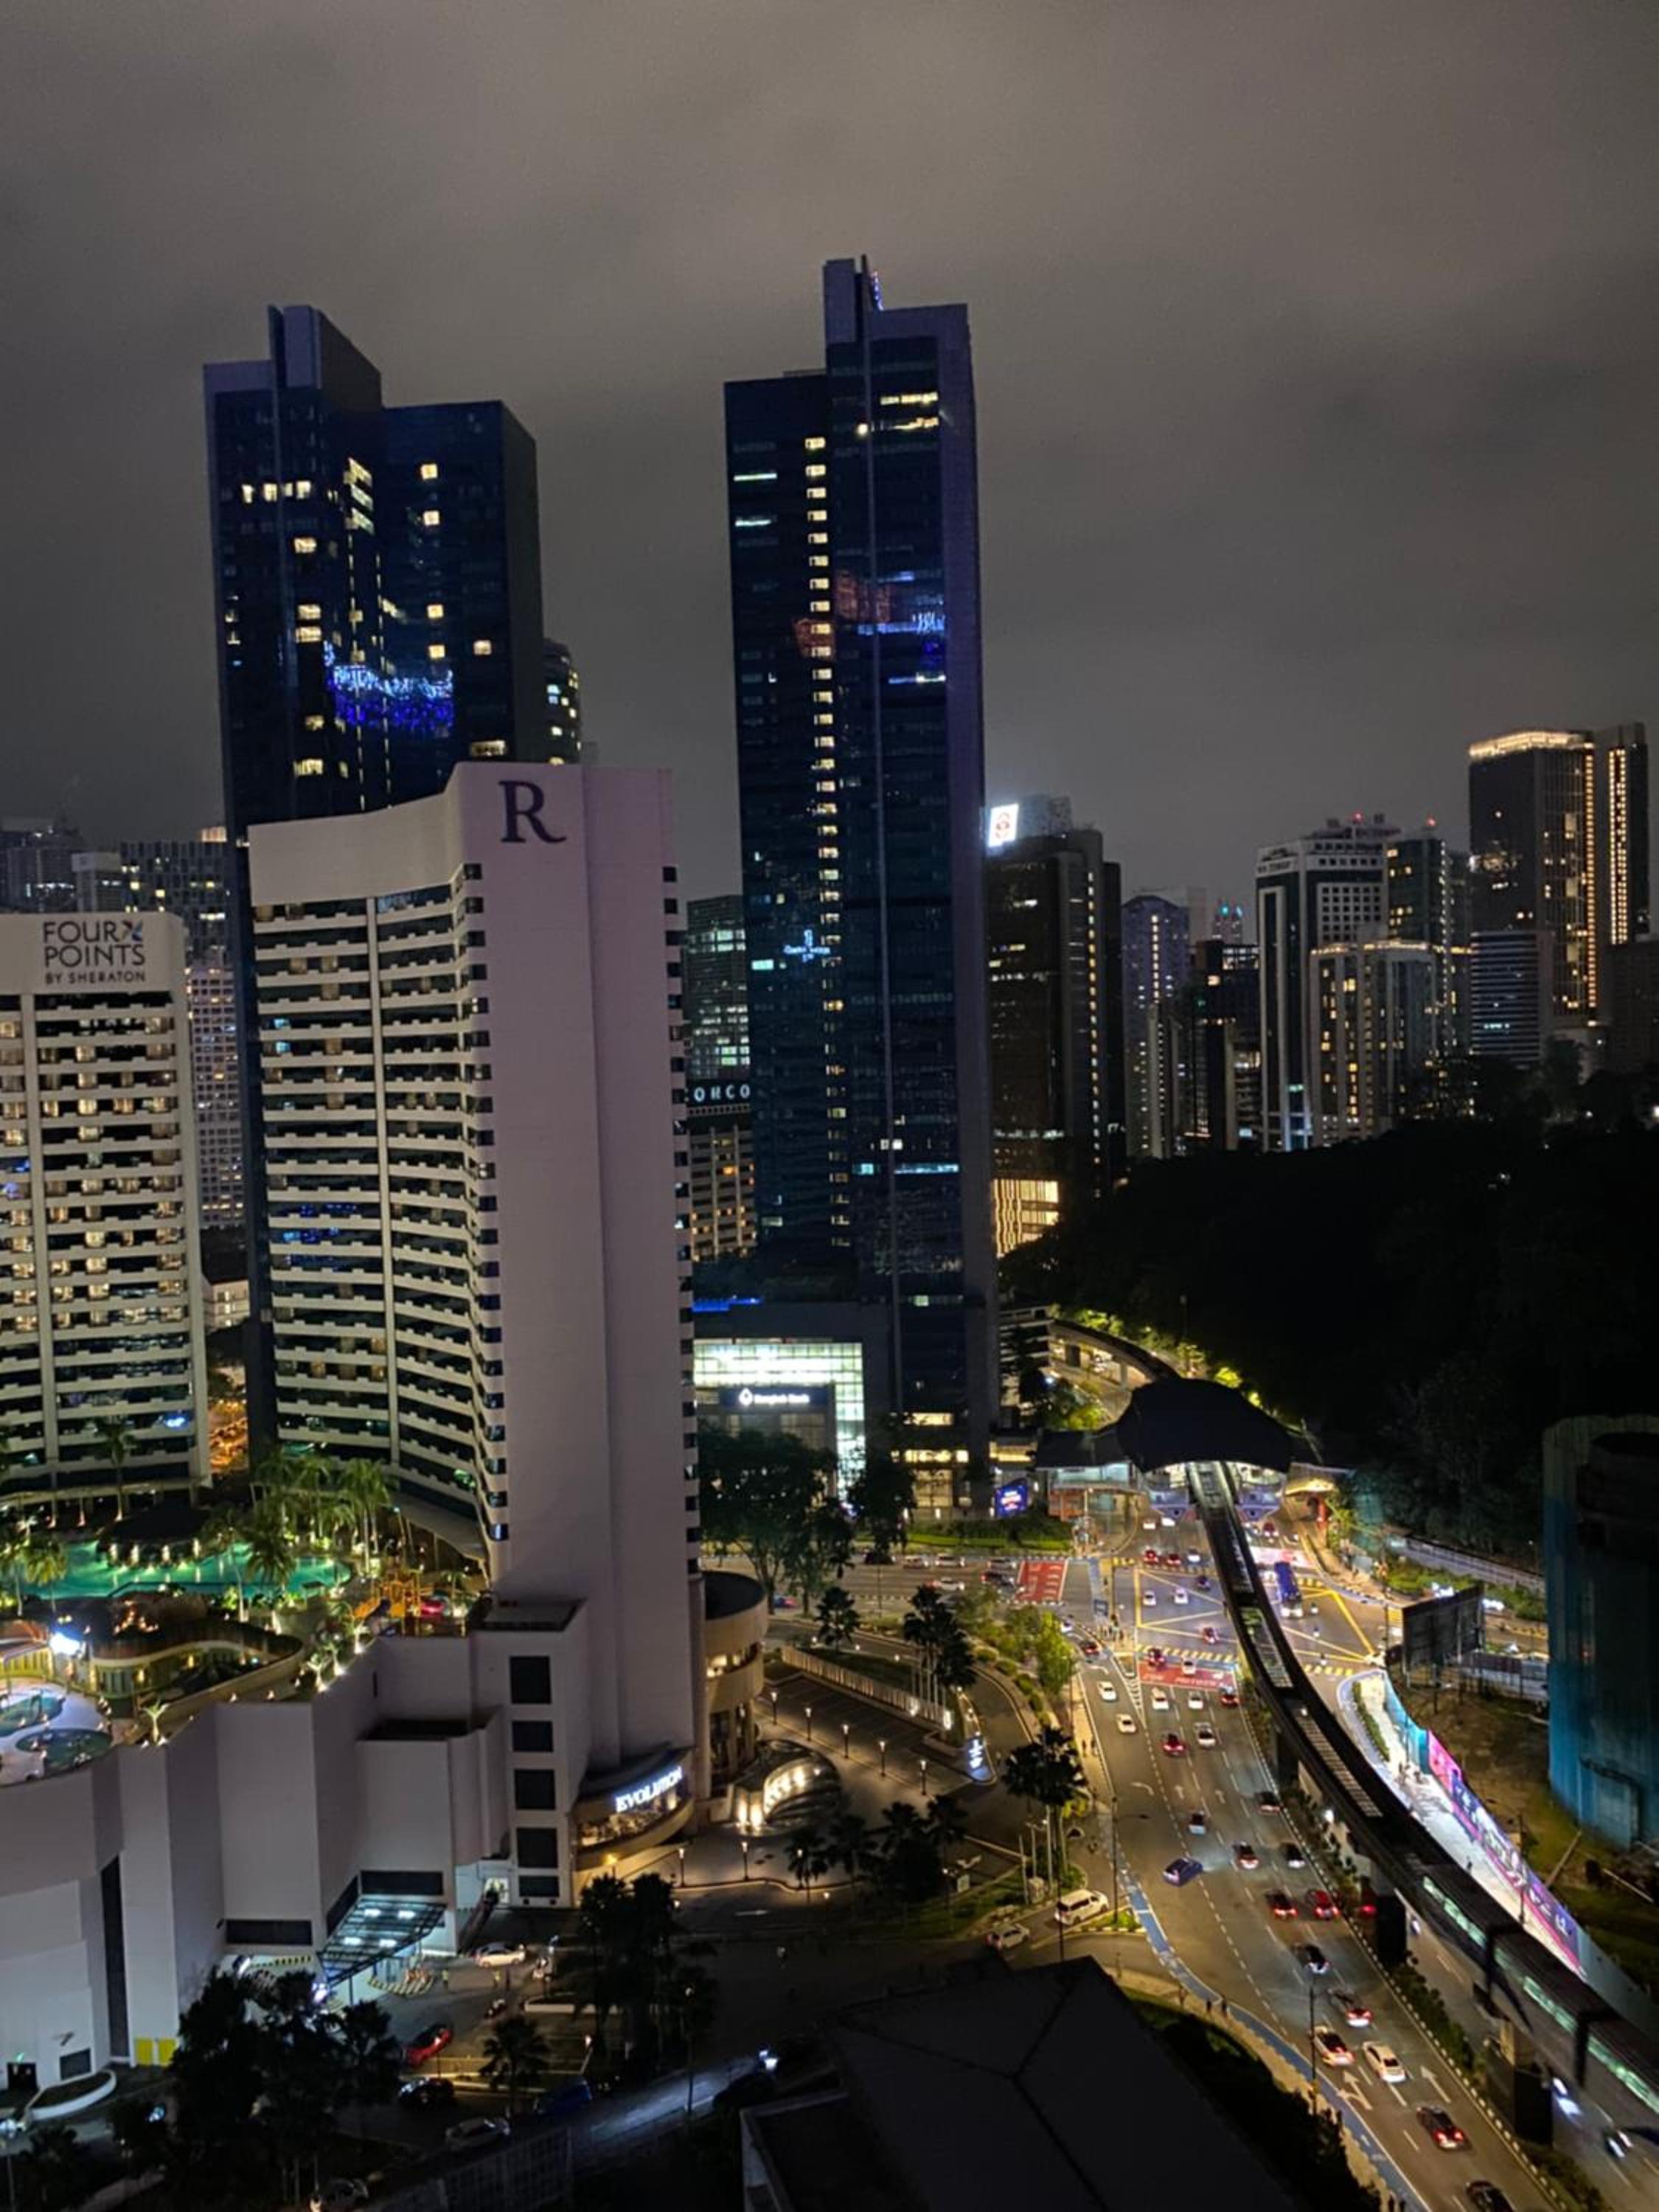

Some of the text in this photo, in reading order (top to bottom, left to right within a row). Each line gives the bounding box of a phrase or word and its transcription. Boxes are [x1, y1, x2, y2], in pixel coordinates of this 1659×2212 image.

[498, 780, 567, 844] R
[43, 921, 119, 943] FOUR
[44, 944, 146, 967] POINTS
[46, 970, 146, 984] BY SHERATON
[684, 1083, 751, 1102] ONCO
